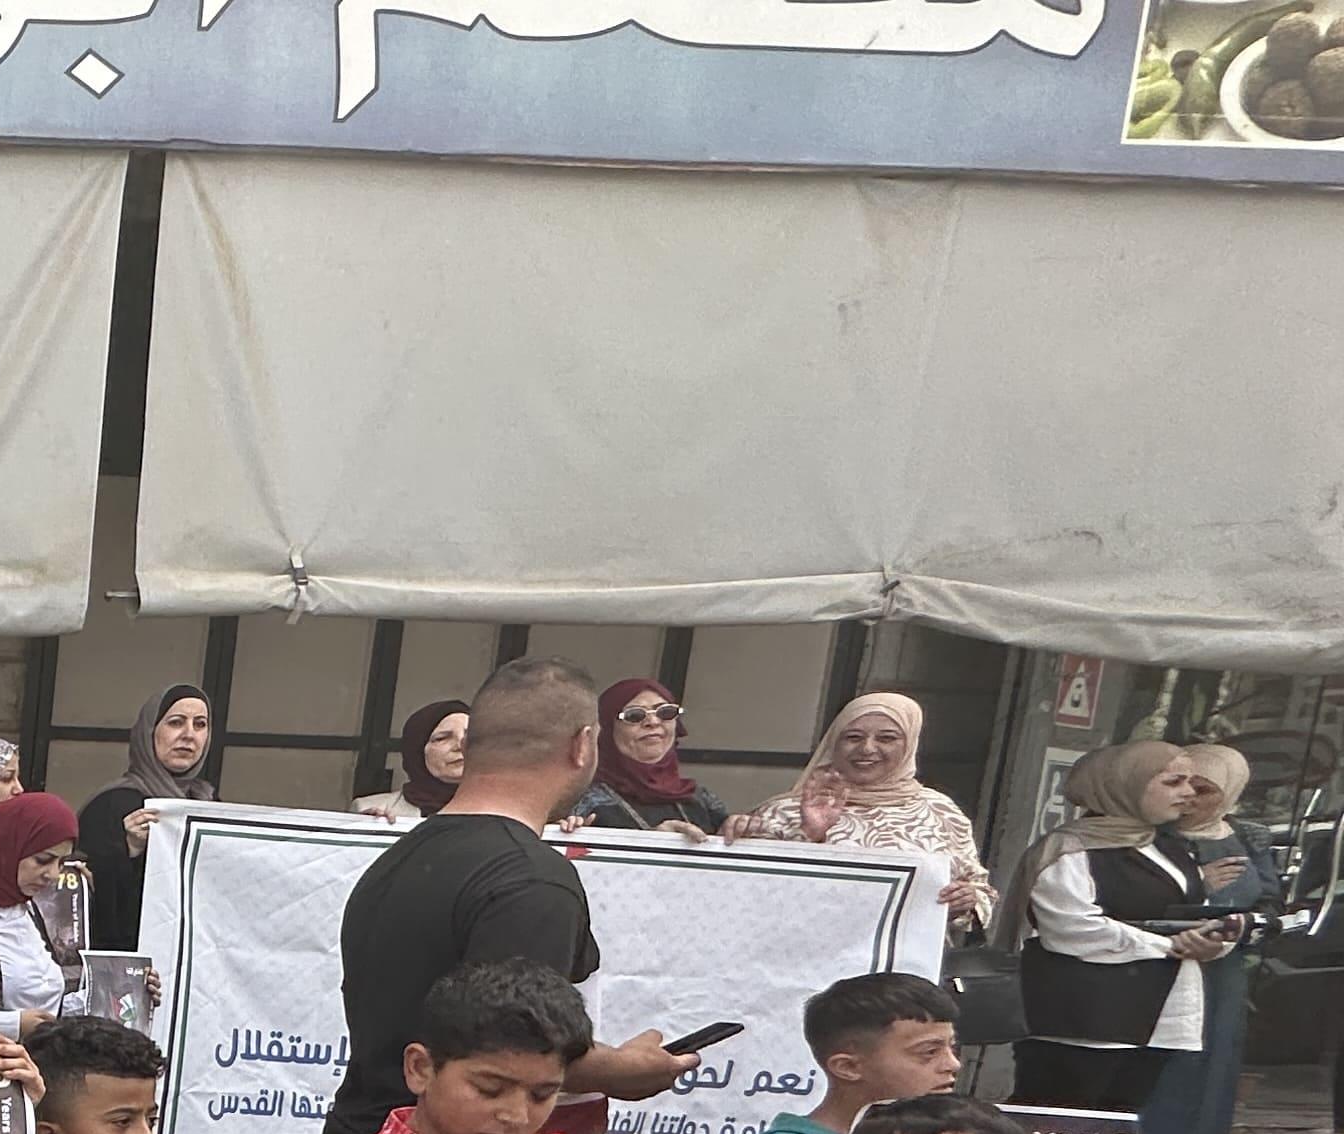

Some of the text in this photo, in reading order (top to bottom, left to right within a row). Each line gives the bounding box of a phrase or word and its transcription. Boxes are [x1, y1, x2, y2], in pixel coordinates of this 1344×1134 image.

[744, 1069, 816, 1096] نعم
[0, 1097, 13, 1134] Years
[208, 1089, 284, 1121] القدس
